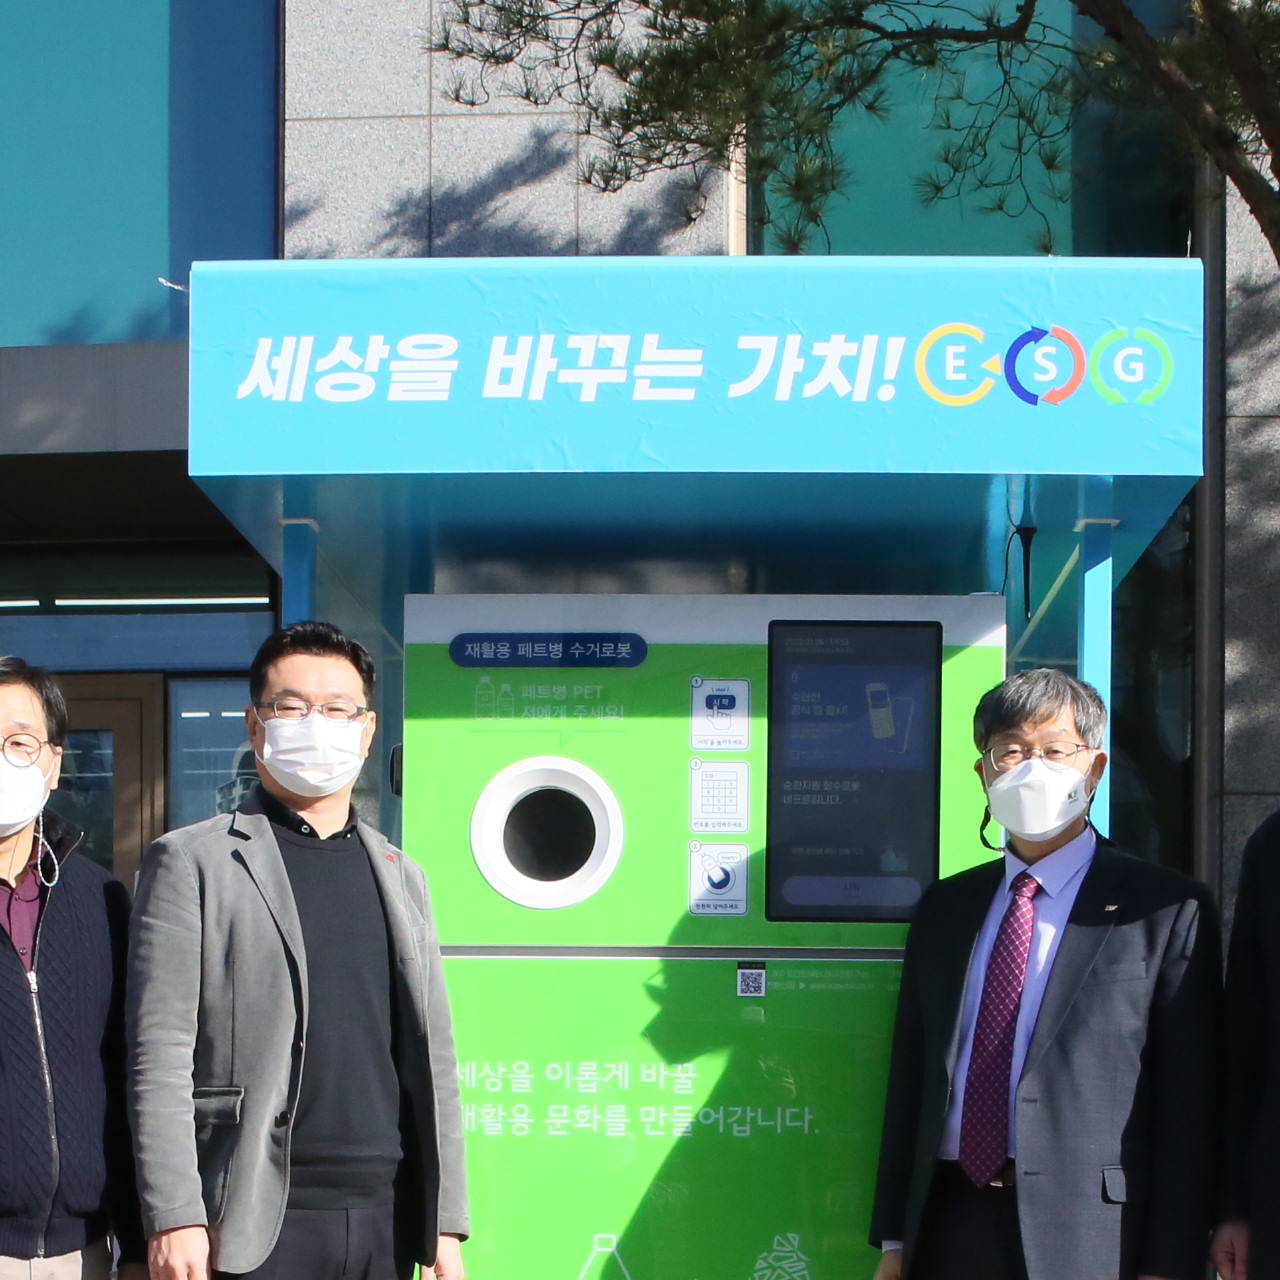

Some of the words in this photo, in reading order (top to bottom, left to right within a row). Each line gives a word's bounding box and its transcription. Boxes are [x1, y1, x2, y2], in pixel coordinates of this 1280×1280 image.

[237, 334, 458, 402] 세상을
[482, 334, 703, 402] 바꾸는
[728, 334, 906, 402] 가치!
[465, 642, 511, 659] 재활용
[517, 642, 563, 659] 페트병
[570, 642, 632, 659] 수거로봇
[521, 685, 567, 700] 페트병
[574, 686, 604, 698] PET
[521, 705, 567, 720] 저에게
[573, 705, 624, 720] 주세요!
[458, 1061, 535, 1093] 세상을
[546, 1061, 629, 1093] 이롭게
[641, 1061, 697, 1094] 바꿀
[544, 1103, 630, 1136] 문화를
[640, 1105, 819, 1137] 만들어갑니다.
